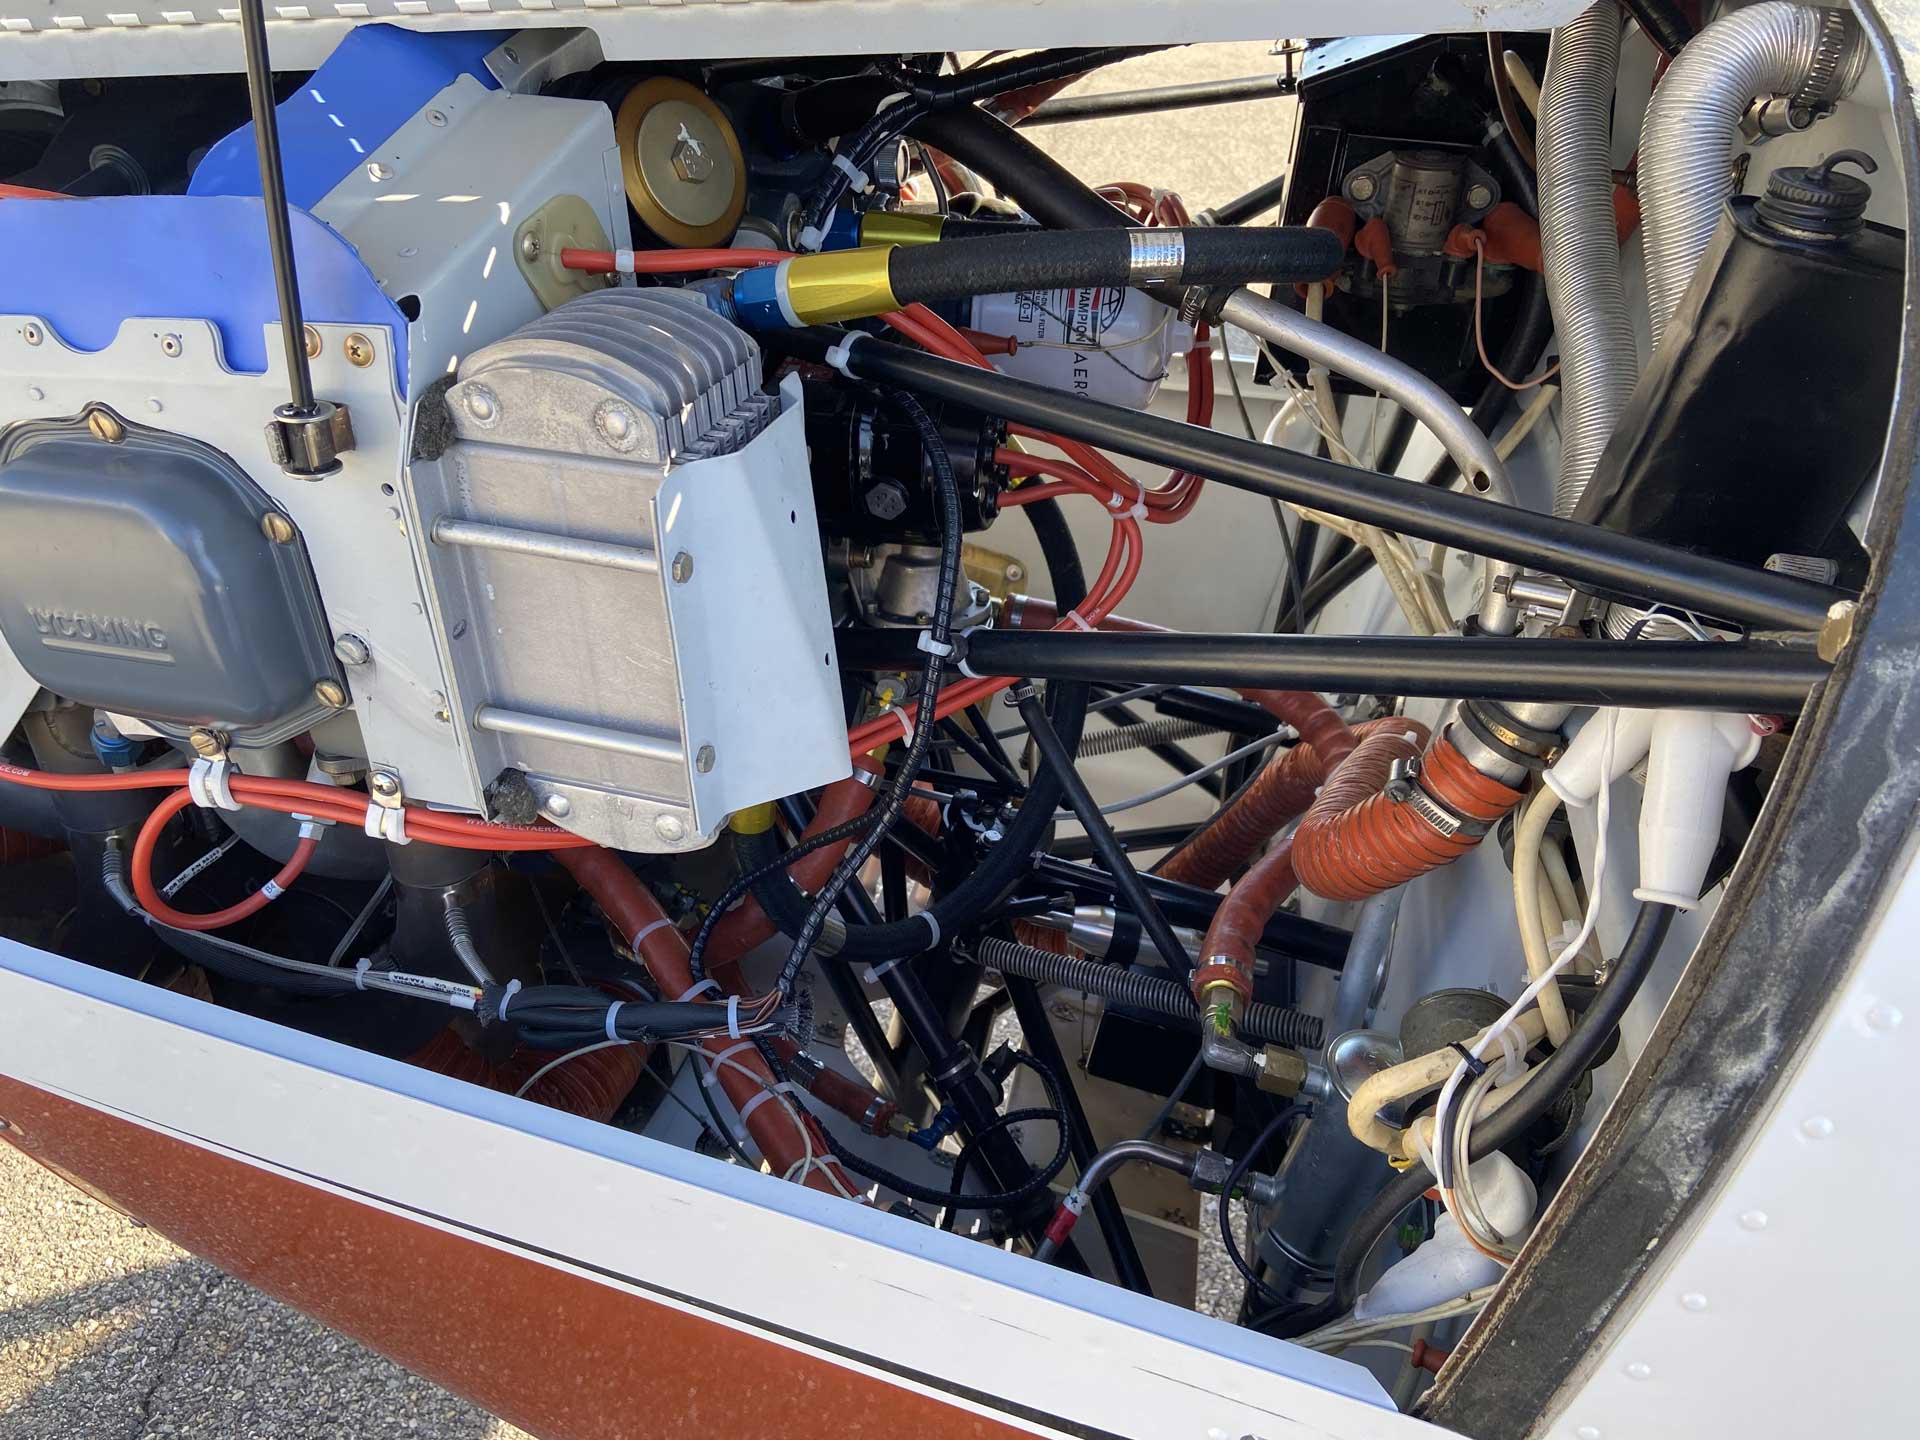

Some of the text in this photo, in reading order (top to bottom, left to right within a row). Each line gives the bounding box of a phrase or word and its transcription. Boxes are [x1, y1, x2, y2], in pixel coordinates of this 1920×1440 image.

[1037, 319, 1046, 338] FILTER
[1075, 288, 1091, 343] HAMPION
[27, 607, 168, 649] LYCOMING
[265, 883, 276, 894] B4
